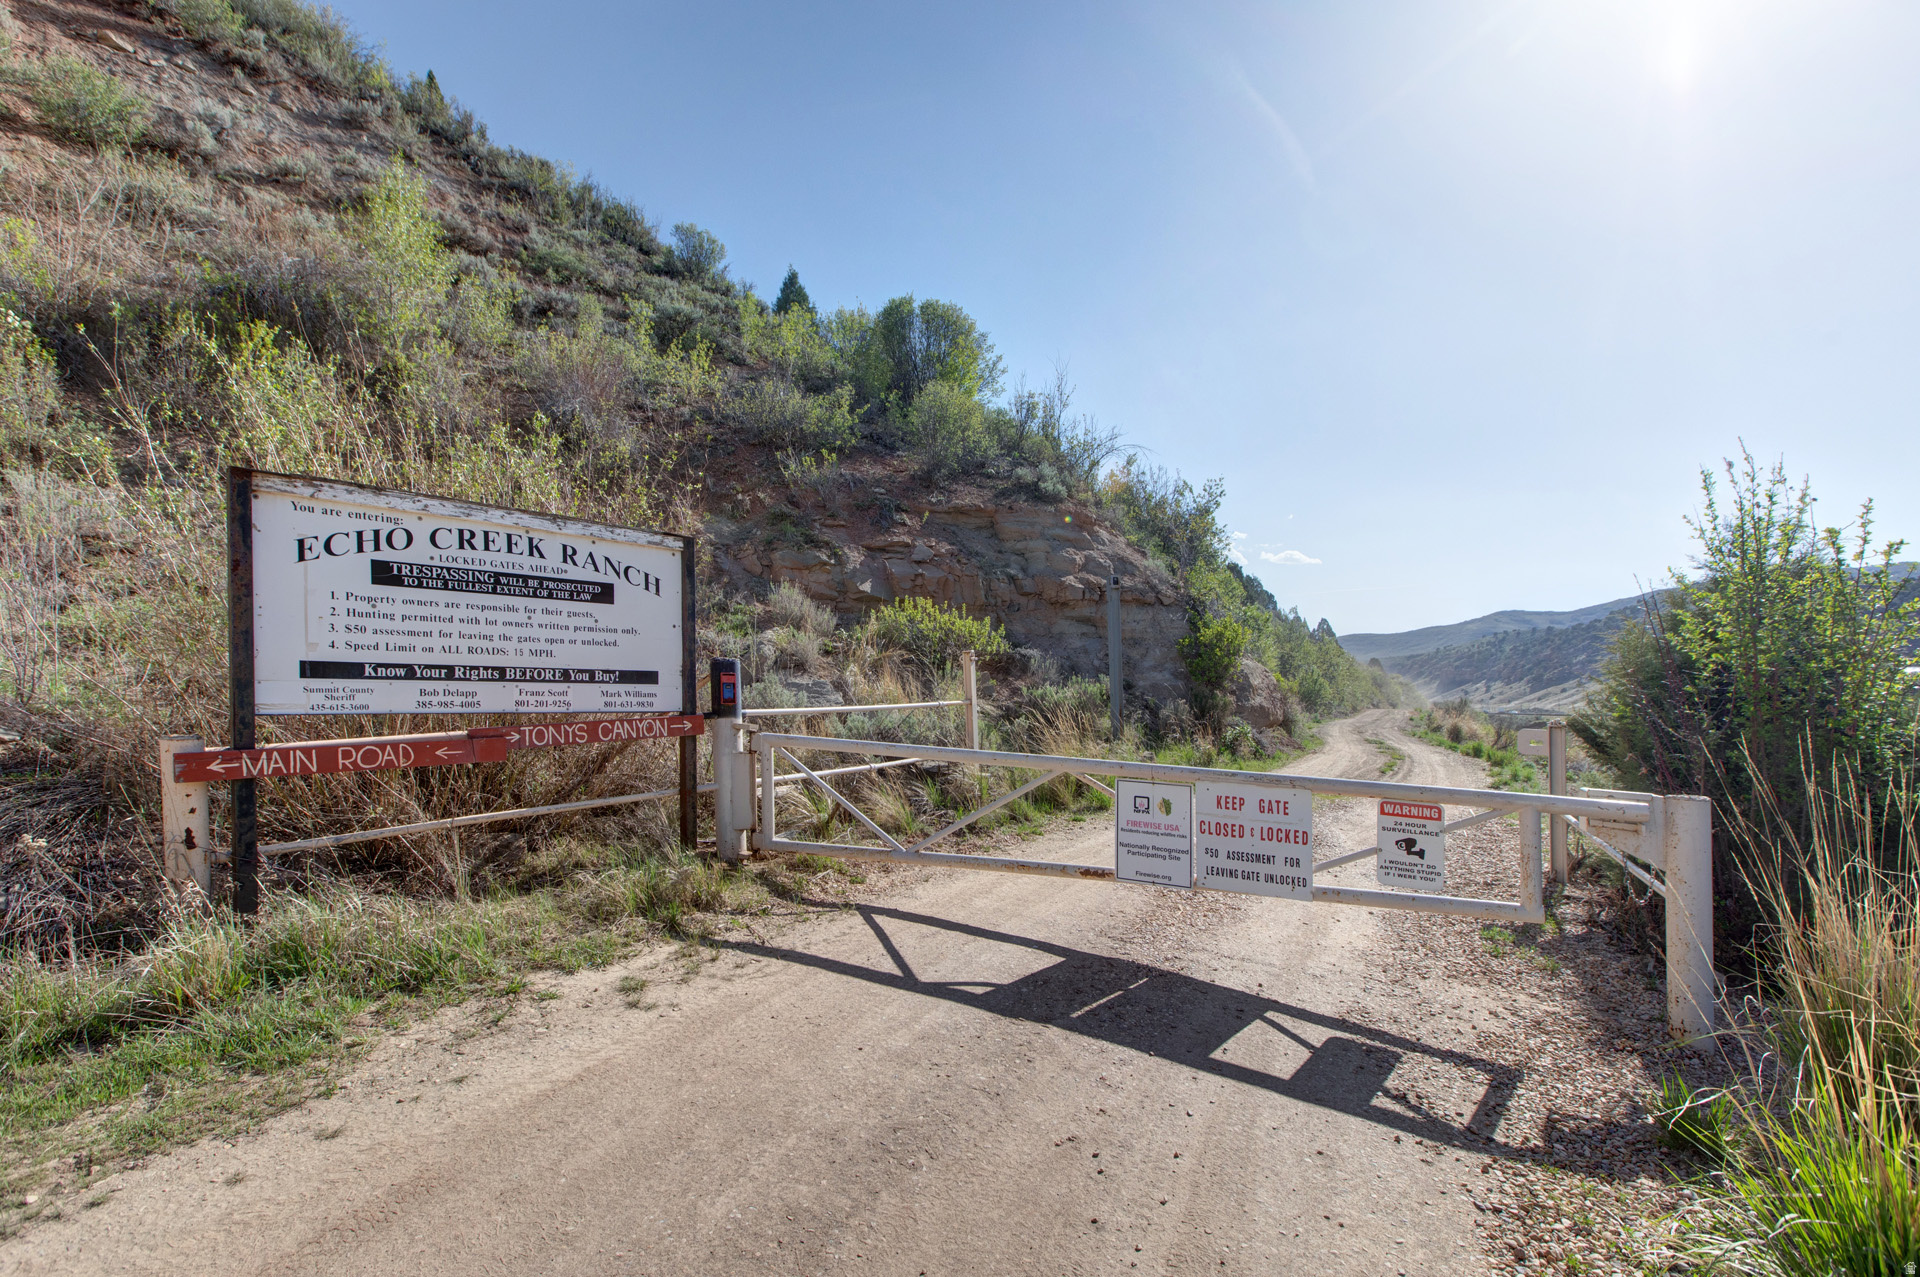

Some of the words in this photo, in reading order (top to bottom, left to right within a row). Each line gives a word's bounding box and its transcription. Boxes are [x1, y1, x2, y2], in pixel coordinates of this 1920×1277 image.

[290, 500, 315, 513] You
[321, 507, 342, 517] are
[348, 511, 404, 526] entering:
[293, 527, 414, 563] ECHO
[429, 527, 547, 560] CREEK
[560, 543, 662, 598] RANCH
[439, 554, 486, 567] LOCKED
[490, 560, 525, 571] GATES
[528, 564, 563, 575] AHEAD
[389, 562, 495, 583] TRESPASSING
[500, 576, 525, 587] WILL
[528, 579, 540, 588] BE
[543, 580, 601, 593] PROSECUTED
[402, 576, 418, 586] TO
[421, 578, 444, 589] THE
[448, 581, 494, 593] FULLEST
[496, 585, 534, 596] EXTENT
[537, 588, 549, 597] OF
[552, 590, 571, 599] THE
[573, 592, 592, 601] LAW
[330, 591, 339, 600] 1.
[345, 591, 397, 606] Property
[402, 598, 440, 607] owners
[444, 601, 461, 609] are
[466, 602, 520, 613] responsible
[524, 605, 537, 615] for
[541, 607, 563, 616] their
[567, 611, 596, 619] guests.
[330, 607, 340, 617] 2.
[346, 608, 396, 621] Hunting
[401, 612, 454, 623] permitted
[458, 616, 480, 625] with
[485, 617, 498, 627] lot
[502, 620, 534, 629] owners
[538, 621, 570, 631] written
[573, 624, 618, 633] permission
[621, 627, 641, 636] only.
[328, 623, 339, 633] 3.
[344, 624, 367, 634] $50
[372, 628, 433, 638] assessment
[438, 630, 453, 639] for
[458, 631, 494, 642] leaving
[498, 633, 513, 642] the
[517, 635, 541, 643] gates
[581, 638, 620, 648] unlocked.
[328, 640, 339, 649] 4.
[344, 640, 379, 652] Speed
[385, 642, 416, 652] Limit
[439, 645, 462, 654] ALL
[467, 645, 509, 656] ROADS:
[514, 648, 524, 656] 15
[529, 648, 557, 658] MPH.
[363, 663, 407, 677] Know
[412, 665, 448, 678] Your
[453, 666, 500, 680] Rights
[504, 667, 564, 680] BEFORE
[568, 669, 590, 681] You
[594, 670, 620, 683] Buy!
[302, 686, 340, 694] Summit
[342, 686, 375, 695] County
[324, 693, 356, 701] Sheriff
[419, 688, 440, 697] Bob
[443, 688, 478, 699] Delapp
[518, 689, 545, 697] Franz
[547, 689, 568, 697] Scott
[600, 690, 622, 698] Mark
[624, 690, 658, 698] Williams
[309, 703, 370, 711] 435-615-3600
[415, 700, 482, 709] 385-985-4005
[514, 699, 572, 708] 801-201-9256
[520, 723, 588, 746] TONYS
[599, 719, 668, 741] CANYON
[242, 749, 317, 777] MAIN
[338, 744, 415, 769] ROAD
[1216, 795, 1245, 811] KEEP
[1259, 798, 1289, 816] GATE
[1383, 803, 1439, 819] WARNING
[1126, 819, 1163, 831] FIREWISE
[1200, 820, 1245, 838] CLOSED
[1260, 826, 1309, 846] LOCKED
[1381, 826, 1440, 837] SURVEILLANCE
[1119, 841, 1150, 851] Nationally
[1151, 845, 1189, 855] Recognized
[1127, 849, 1167, 860] Participating
[1204, 847, 1219, 859] $50
[1226, 850, 1276, 865] ASSESSMENT
[1284, 856, 1301, 869] FOR
[1388, 859, 1425, 868] WOULDN'T
[1135, 870, 1172, 881] Firewise.org
[1206, 865, 1239, 879] LEAVING
[1241, 870, 1260, 882] GATE
[1264, 873, 1307, 888] UNLOCKED
[1380, 865, 1415, 873] ANYTHING
[1416, 869, 1442, 877] STUPID
